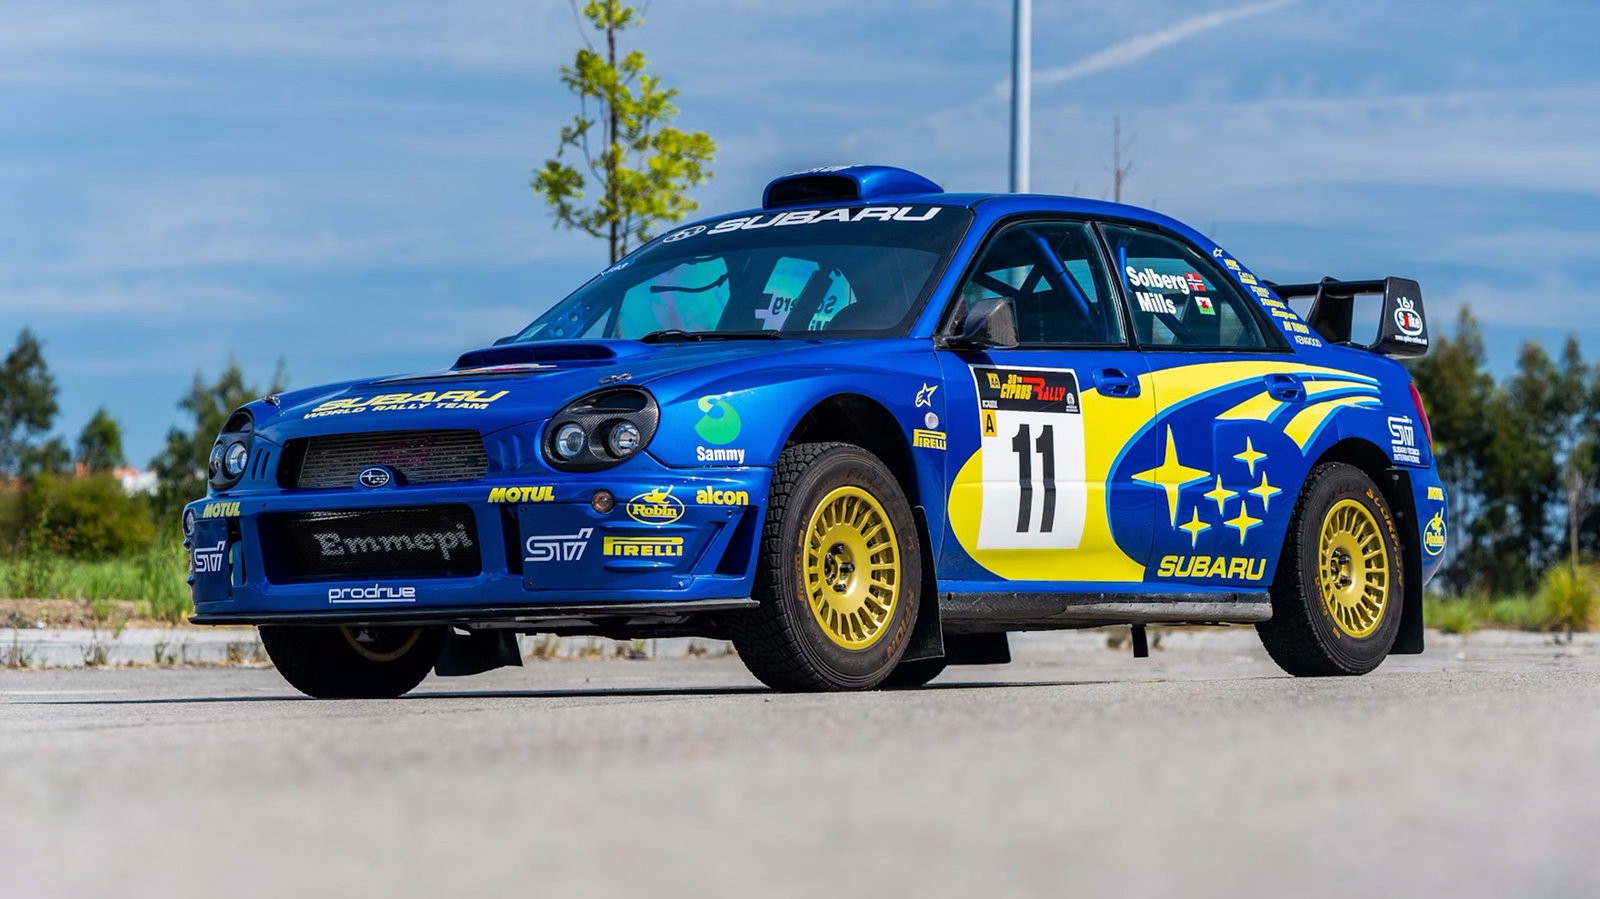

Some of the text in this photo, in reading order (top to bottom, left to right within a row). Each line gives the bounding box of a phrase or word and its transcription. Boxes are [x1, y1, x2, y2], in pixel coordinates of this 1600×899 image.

[707, 207, 943, 235] SUBARU
[1125, 265, 1190, 295] Solberg
[1135, 291, 1177, 315] Mills
[1000, 376, 1066, 401] CYPRUS RALLY
[303, 401, 490, 420] WORLD RALLY TEAM
[311, 390, 511, 413] SUBARU
[985, 413, 995, 433] A
[913, 428, 947, 450] PIRELLI
[696, 445, 745, 464] Sammy
[1011, 423, 1057, 533] 11
[487, 486, 555, 503] MOTUL
[695, 485, 749, 506] alcon
[202, 501, 241, 519] MOTUL
[632, 503, 678, 518] Robin
[314, 522, 473, 561] Emmepi
[603, 536, 684, 556] PIRELLI
[1157, 555, 1267, 581] SUBARU
[328, 583, 416, 604] prodrive
